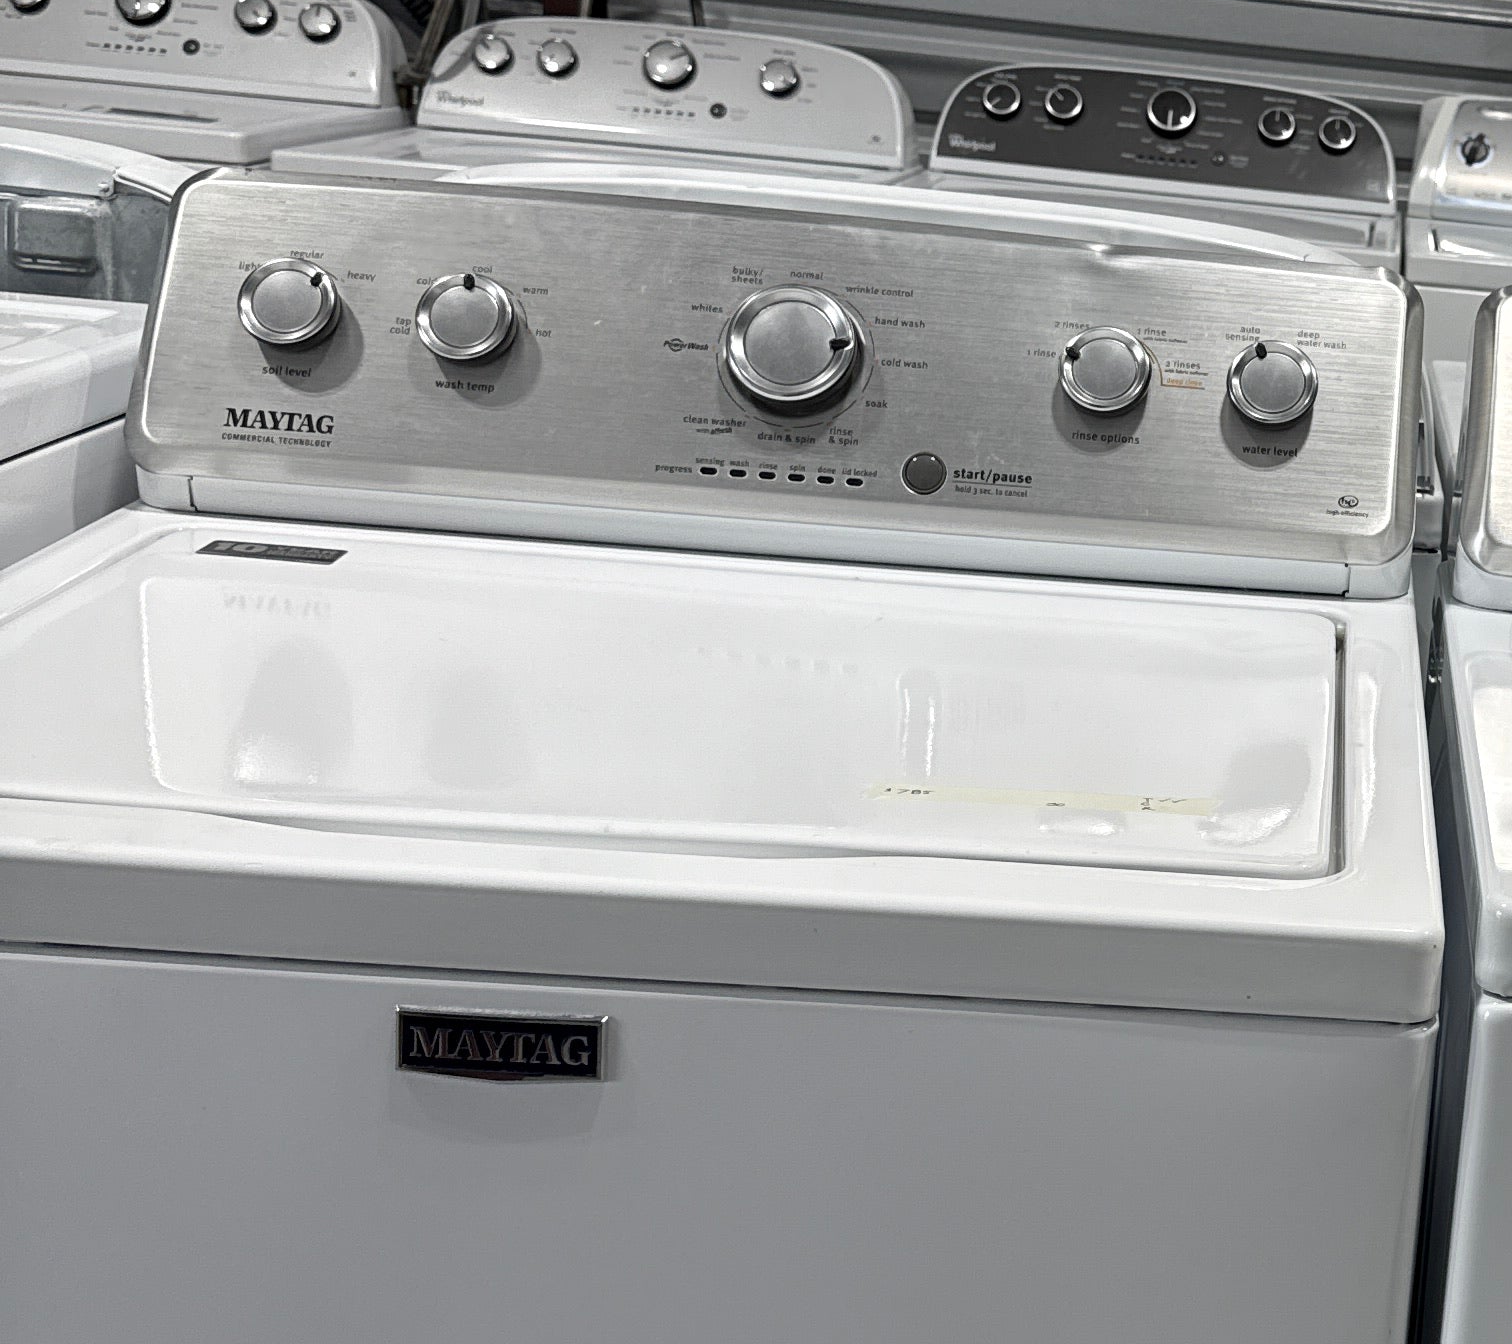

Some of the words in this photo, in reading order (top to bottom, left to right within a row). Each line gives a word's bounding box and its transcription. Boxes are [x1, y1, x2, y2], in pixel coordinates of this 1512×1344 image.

[290, 249, 324, 260] regular
[472, 265, 493, 274] cool
[732, 266, 763, 277] bulky/
[790, 269, 824, 281] normal
[347, 270, 376, 282] heavy
[731, 275, 764, 285] sheets
[522, 287, 549, 295] warm
[845, 285, 879, 295] wrinkle
[881, 287, 914, 298] control
[691, 303, 723, 313] whites
[396, 317, 411, 327] tap
[875, 317, 899, 327] hand
[901, 318, 926, 329] wash
[1063, 321, 1090, 331] rinses
[390, 325, 410, 335] cold
[535, 328, 552, 337] hot
[1144, 327, 1167, 337] rinse
[1240, 325, 1261, 334] auto
[1297, 330, 1320, 340] deep
[1225, 332, 1260, 343] sensing
[1297, 339, 1320, 348] water
[1322, 340, 1347, 350] wash
[1027, 349, 1031, 357] 1
[1033, 349, 1057, 359] rinse
[881, 358, 901, 368] cold
[903, 360, 928, 369] wash
[1174, 361, 1201, 370] rinses
[262, 365, 282, 377] soil
[285, 365, 312, 378] level
[435, 379, 464, 391] wash
[466, 381, 495, 394] temp
[865, 398, 888, 409] soak
[223, 407, 335, 435] MAYTAG
[683, 414, 709, 425] clean
[711, 417, 747, 428] washer
[829, 426, 854, 436] rinse
[221, 432, 275, 444] COMMERCIAL
[278, 436, 332, 448] TECHNOLOGY
[758, 431, 782, 442] drain
[785, 435, 792, 443] &
[794, 434, 816, 445] spin
[828, 435, 836, 444] &
[838, 436, 859, 447] spin
[1071, 430, 1098, 443] rinse
[1100, 432, 1141, 445] options
[1242, 444, 1271, 457] water
[1273, 445, 1298, 458] level
[696, 457, 725, 467] sensing
[729, 458, 750, 467] wash
[654, 464, 693, 475] progress
[789, 464, 806, 474] spin
[817, 466, 836, 474] done
[852, 468, 878, 478] locked
[953, 467, 1033, 486] start/pause
[954, 485, 971, 494] hold
[1005, 489, 1028, 499] cancel
[213, 541, 269, 554] 10
[409, 1026, 592, 1066] MAYTAG
